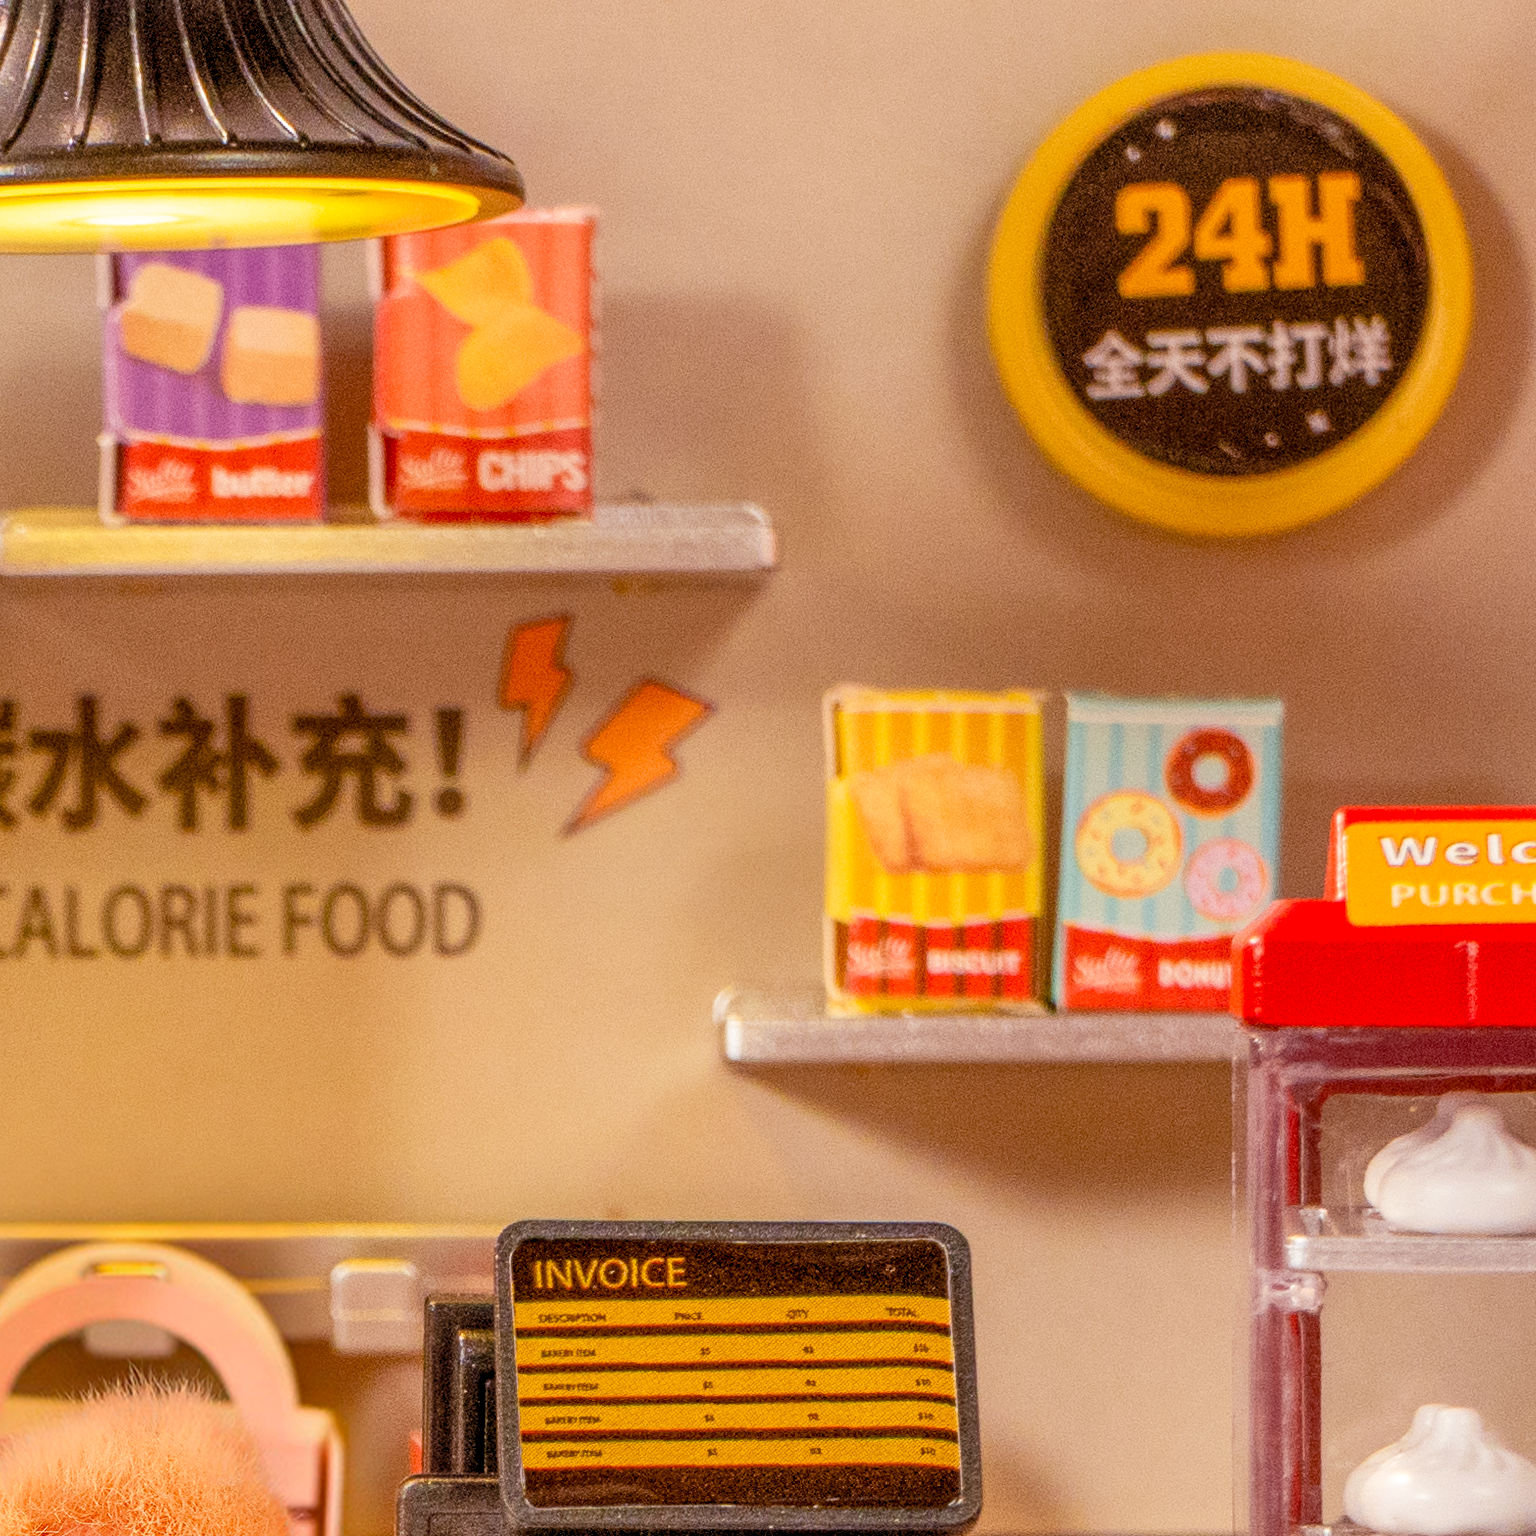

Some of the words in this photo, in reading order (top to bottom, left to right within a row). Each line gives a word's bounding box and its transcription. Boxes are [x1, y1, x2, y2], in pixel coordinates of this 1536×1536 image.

[1115, 171, 1365, 299] 24H
[1082, 315, 1392, 400] 全天不打烊
[476, 449, 587, 493] CHIPS
[283, 880, 482, 960] FOOD
[1158, 958, 1232, 989] DONU
[534, 1257, 687, 1290] INVOICE
[538, 1312, 607, 1324] DESCRIPTION
